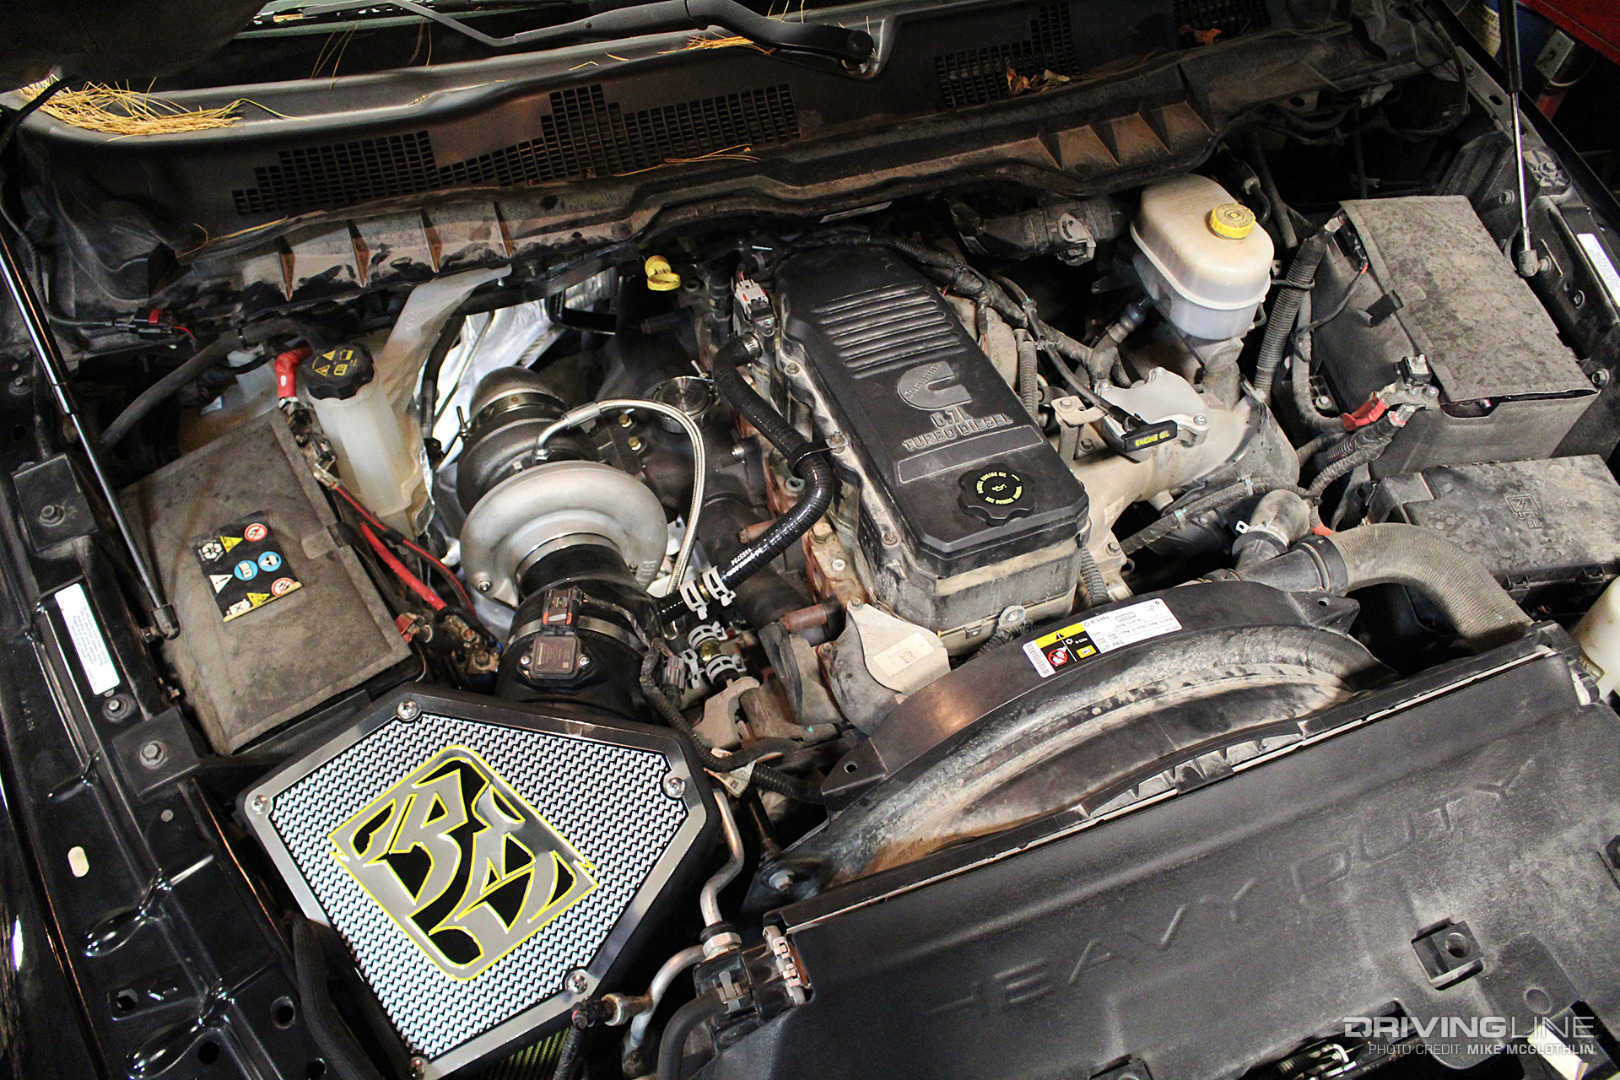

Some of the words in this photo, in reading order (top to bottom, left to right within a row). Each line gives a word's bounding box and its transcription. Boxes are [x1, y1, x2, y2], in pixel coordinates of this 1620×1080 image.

[902, 426, 957, 452] TURBO
[956, 412, 1014, 436] DIESEL
[930, 406, 974, 429] 6.7L
[1135, 433, 1159, 447] ENGINE
[1159, 430, 1170, 440] OIL
[1291, 757, 1535, 903] DUTY
